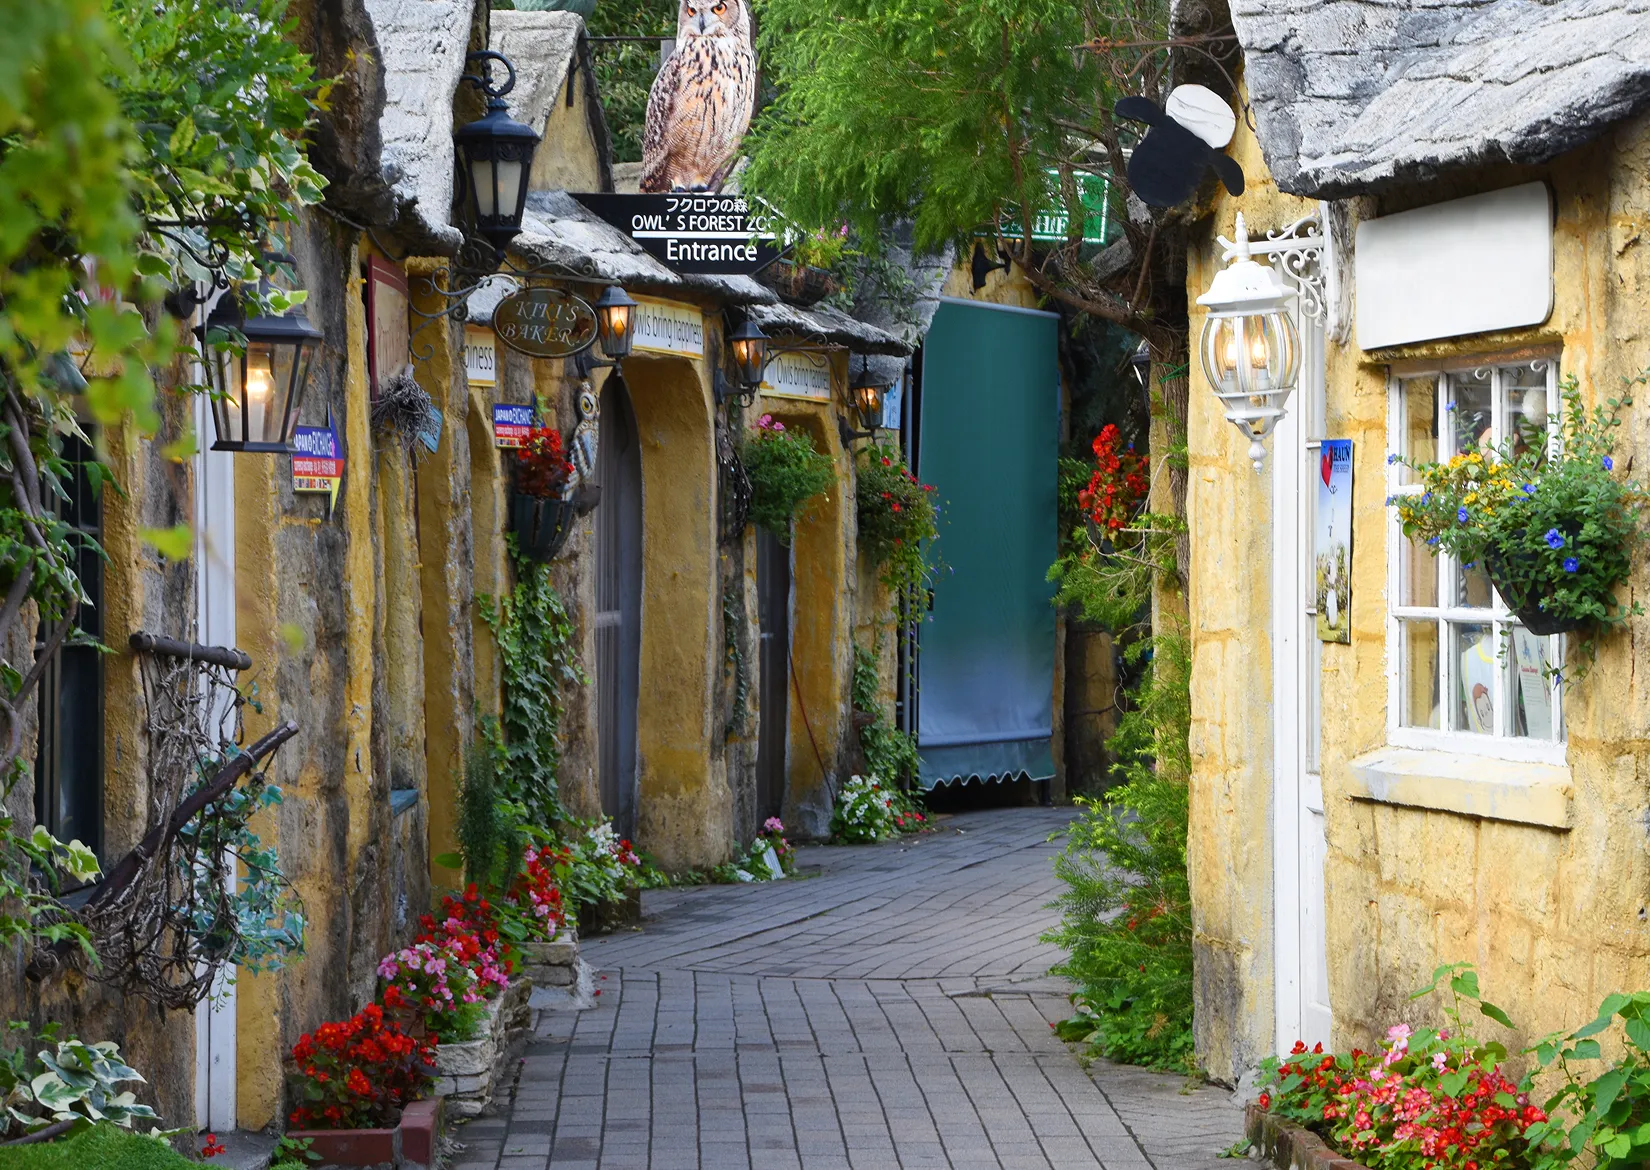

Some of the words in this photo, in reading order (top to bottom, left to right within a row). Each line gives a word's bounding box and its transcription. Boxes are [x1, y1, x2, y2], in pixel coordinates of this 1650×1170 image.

[666, 198, 748, 213] フクロウの森
[689, 215, 744, 231] FOREST
[666, 239, 758, 262] Entrance
[633, 305, 651, 336] wls
[652, 306, 672, 348] bring
